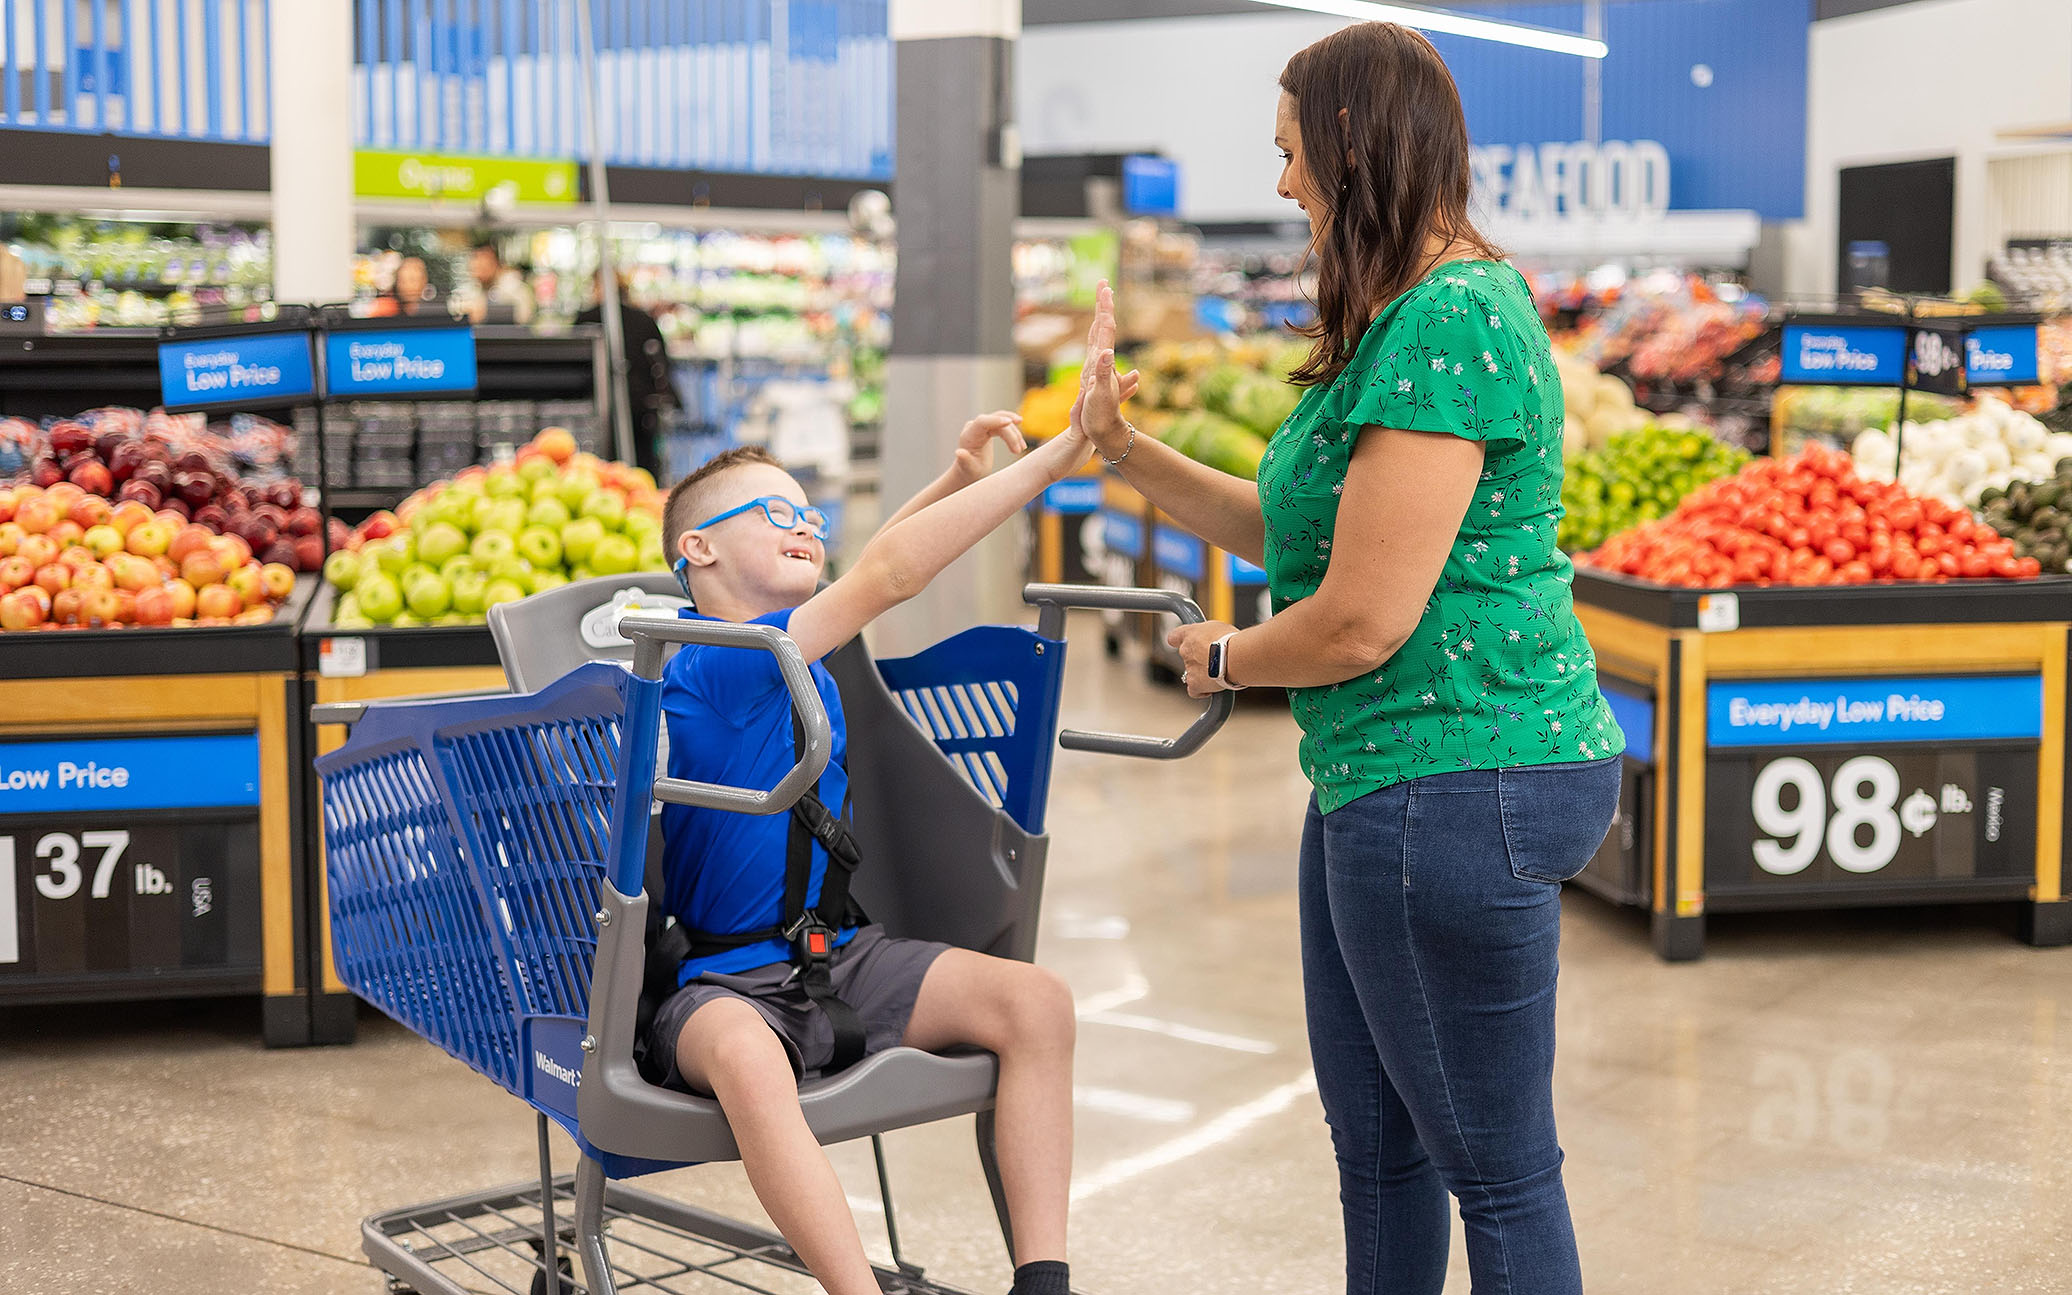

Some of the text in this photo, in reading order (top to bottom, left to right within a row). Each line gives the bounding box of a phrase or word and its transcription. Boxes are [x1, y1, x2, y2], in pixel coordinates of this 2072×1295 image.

[351, 356, 445, 381] Low Price
[1969, 349, 2013, 371] Price
[186, 364, 281, 391] Low Price
[1729, 694, 1945, 732] Everyday Low Price
[57, 761, 130, 789] Price
[1940, 783, 1974, 814] lb.
[1985, 785, 2005, 843] Mexico
[35, 830, 174, 900] 37 lb.
[191, 877, 213, 918] USA
[535, 1050, 576, 1087] Walmart
